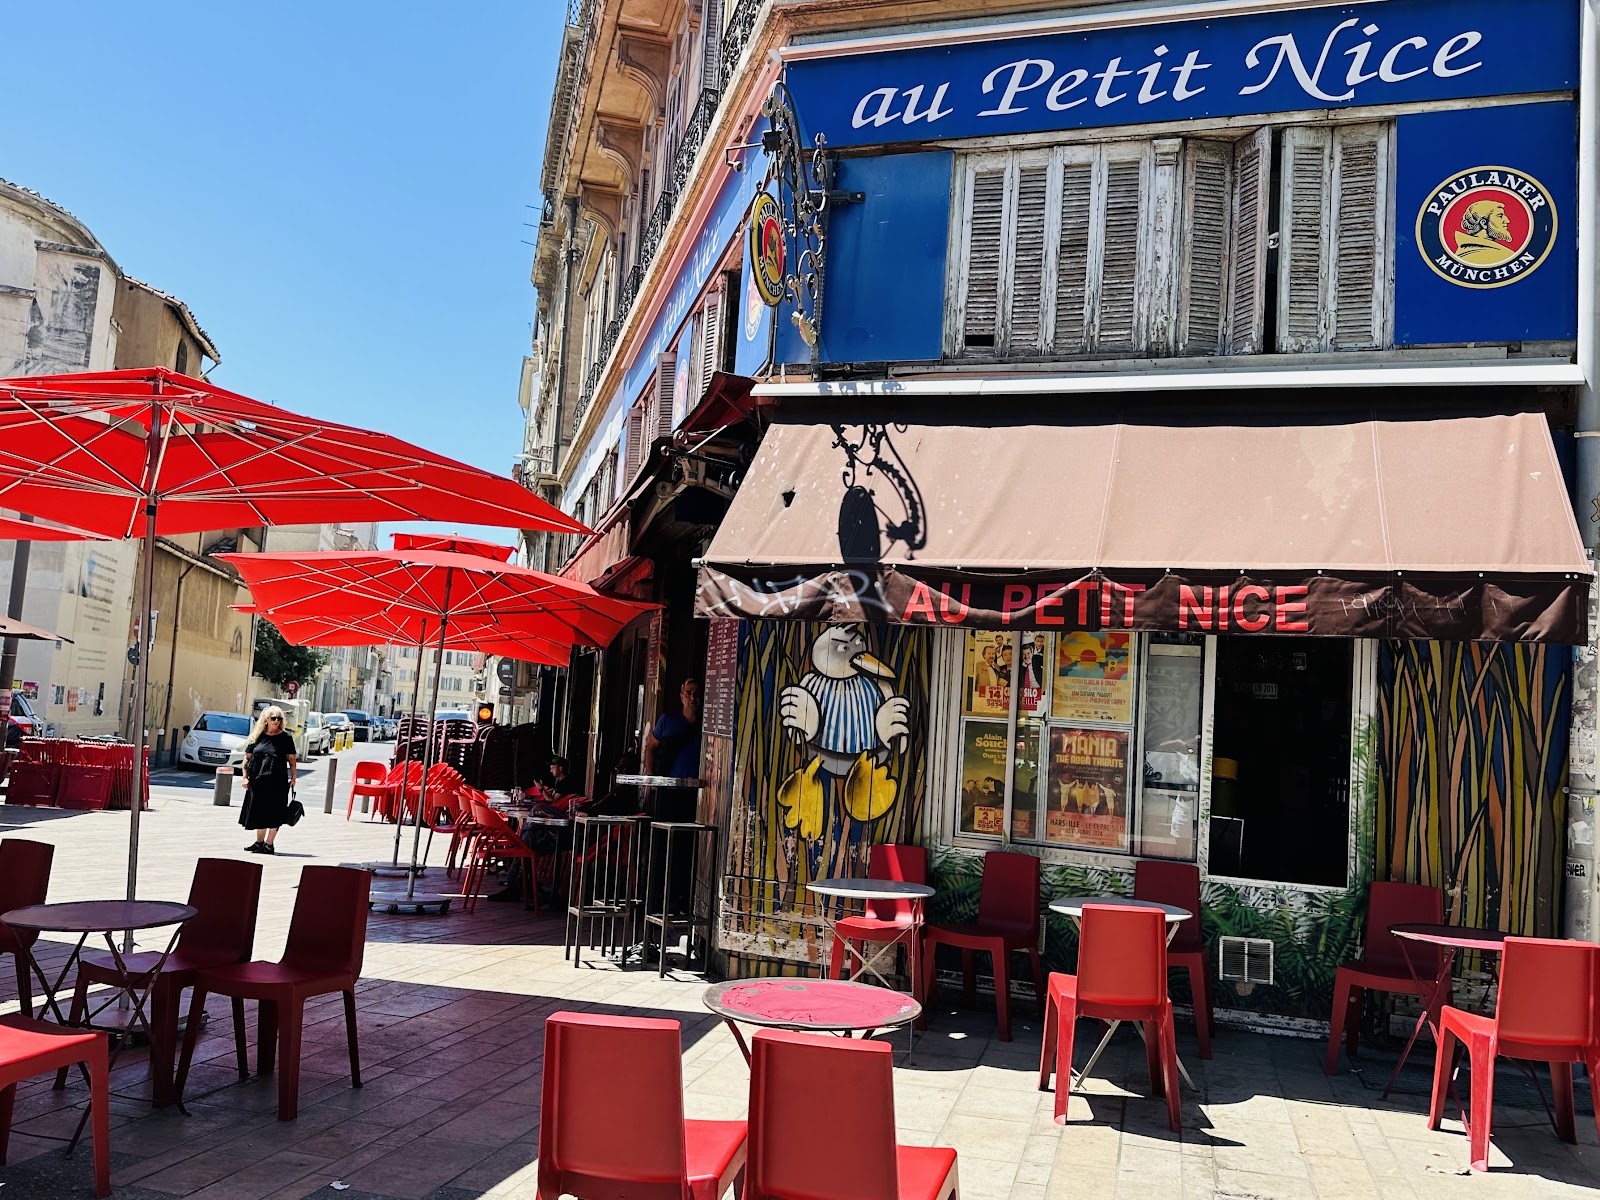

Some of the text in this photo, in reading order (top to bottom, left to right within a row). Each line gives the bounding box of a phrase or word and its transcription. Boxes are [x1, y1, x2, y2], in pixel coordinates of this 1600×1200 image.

[852, 18, 1482, 129] au Petit Nice
[1427, 171, 1546, 217] PAULANER
[1435, 252, 1536, 282] MÜNCHEN
[902, 581, 971, 624] AU
[1001, 581, 1147, 627] PETIT
[1179, 585, 1309, 631] NICE
[989, 690, 1001, 698] 14
[1023, 688, 1038, 697] SILO
[983, 733, 1003, 741] Alain
[1062, 733, 1117, 758] MANIA
[1055, 754, 1124, 768] THE ABBA TRIBUTE
[982, 811, 989, 820] 2
[1049, 818, 1080, 828] MARSEILLE
[1085, 821, 1092, 829] LE
[1093, 823, 1111, 832] CEPAC
[1091, 829, 1103, 837] 2024
